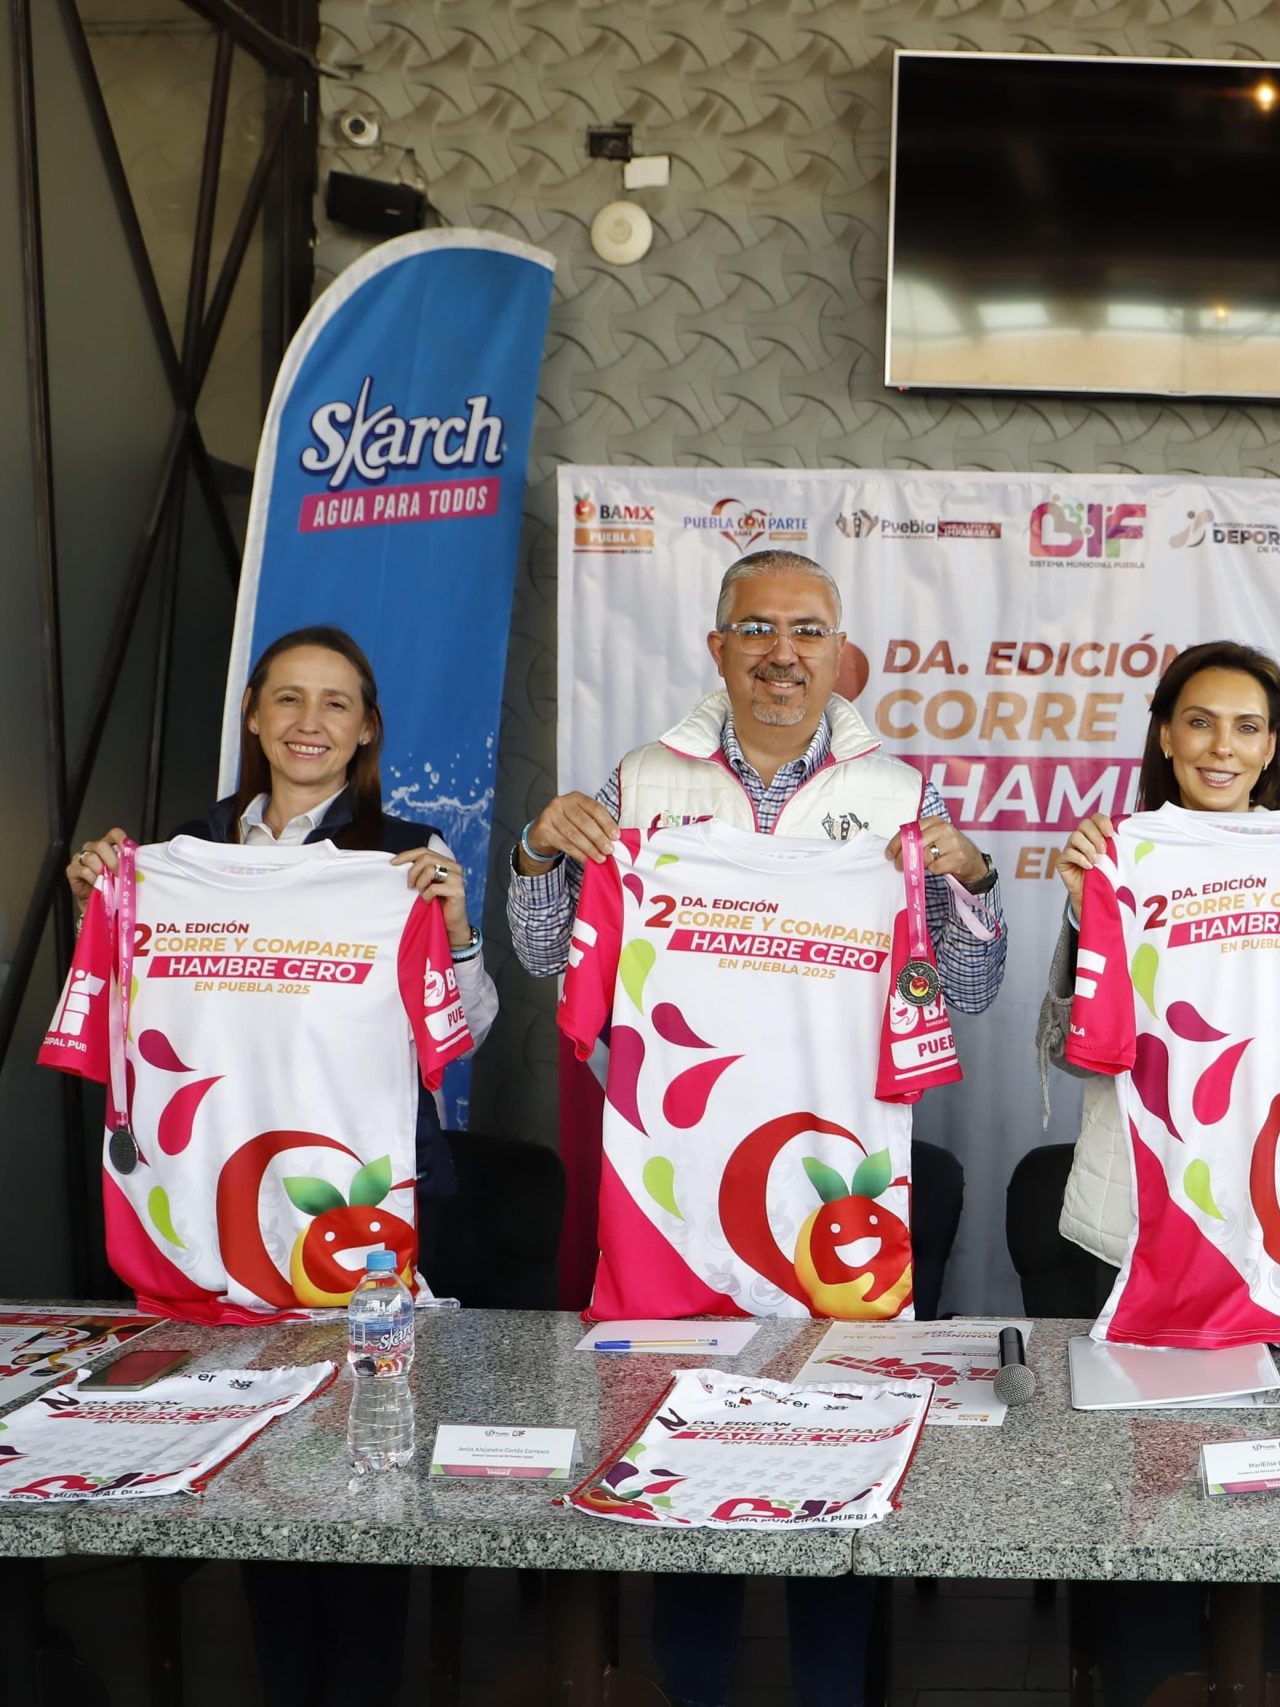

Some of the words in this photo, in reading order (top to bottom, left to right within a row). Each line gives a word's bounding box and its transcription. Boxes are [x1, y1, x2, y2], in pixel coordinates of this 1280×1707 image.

[301, 375, 504, 489] Skarch
[312, 497, 364, 528] AGUA
[373, 490, 420, 519] PARA
[429, 485, 488, 514] TODOS
[599, 505, 655, 521] BAMX
[684, 516, 735, 530] PUEBLA
[881, 519, 936, 534] Puebla
[589, 532, 637, 543] PUEBLA
[1257, 546, 1270, 554] DE
[883, 640, 969, 675] DA.
[875, 689, 1124, 742] CORRE
[926, 763, 1140, 823] HAM
[644, 894, 677, 928] 2
[681, 896, 707, 908] DA.
[712, 898, 779, 914] EDICIÓN
[1142, 894, 1168, 932] 2
[1171, 887, 1197, 901] DA.
[1202, 875, 1267, 895] EDICIÓN
[1171, 893, 1246, 920] CORRE
[1252, 892, 1266, 907] Y
[133, 923, 151, 957] 2
[156, 923, 180, 934] DA.
[185, 920, 249, 934] EDICIÓN
[677, 910, 755, 930] CORRE
[762, 916, 776, 931] Y
[780, 919, 891, 950] COMPARTE
[154, 937, 226, 952] CORRE
[233, 937, 249, 952] Y
[253, 938, 378, 960] COMPARTE
[690, 932, 803, 959] HAMBRE
[809, 943, 877, 969] CERO
[1221, 942, 1238, 954] EN
[168, 957, 275, 977] HAMBRE
[283, 960, 356, 982] CERO
[718, 958, 738, 969] EN
[742, 960, 799, 975] PUEBLA
[803, 966, 836, 980] 2025
[195, 981, 214, 992] EN
[218, 982, 273, 993] PUEBLA
[277, 984, 311, 995] 2025
[917, 1035, 955, 1058] PUEB
[73, 1404, 156, 1412] CORRE
[74, 1411, 193, 1420] HAMBRE
[198, 1411, 252, 1420] CER
[684, 1425, 771, 1433] CORRE
[772, 1425, 786, 1433] Y
[695, 1432, 808, 1442] HAMBRE
[821, 1431, 893, 1443] CERO
